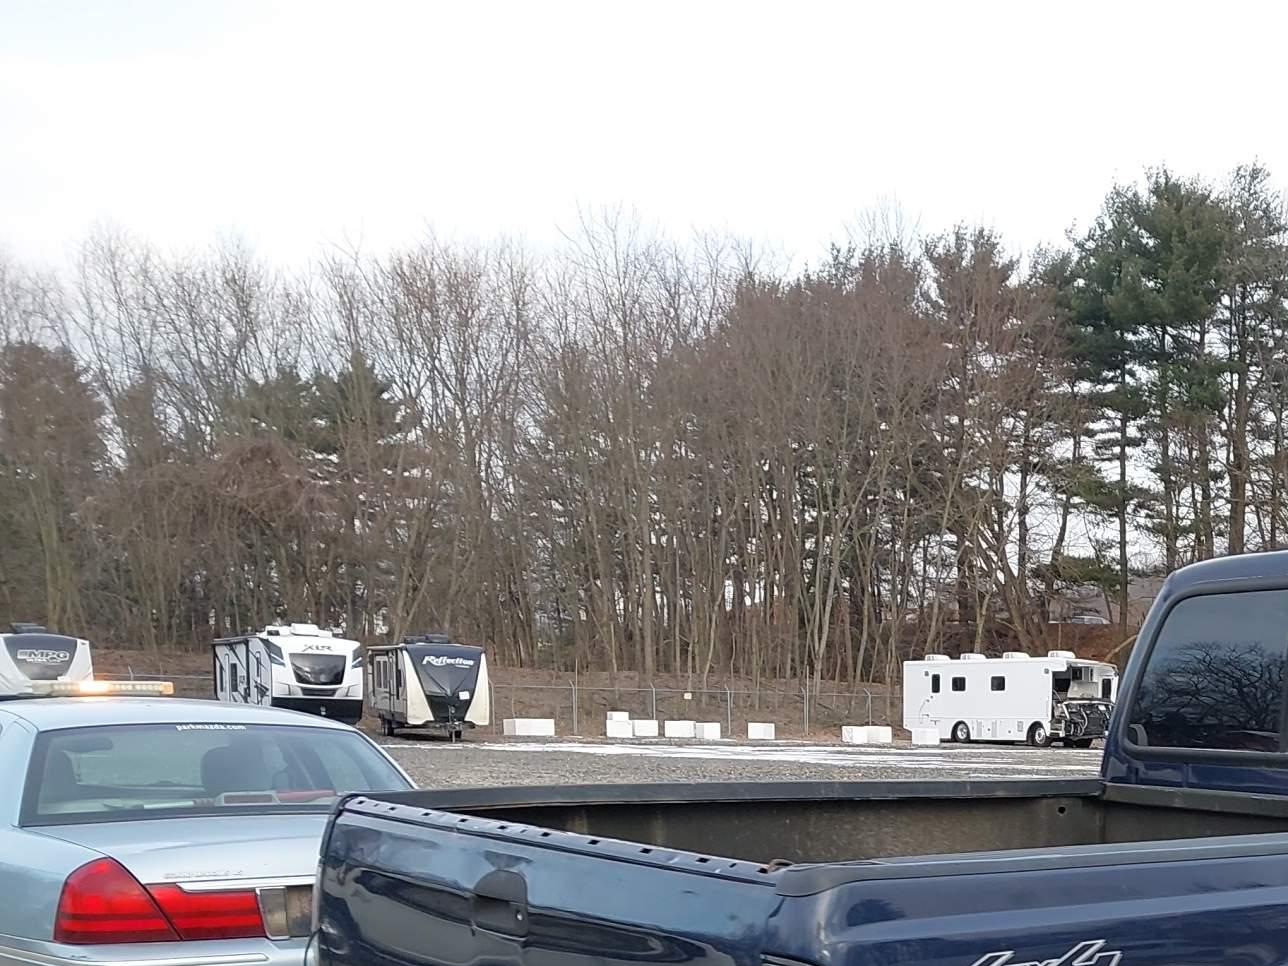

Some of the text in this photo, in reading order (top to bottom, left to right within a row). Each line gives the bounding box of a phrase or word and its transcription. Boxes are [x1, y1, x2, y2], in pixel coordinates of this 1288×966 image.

[26, 649, 70, 660] MPG
[421, 655, 475, 667] Reflection
[175, 723, 247, 732] parkmazda.com
